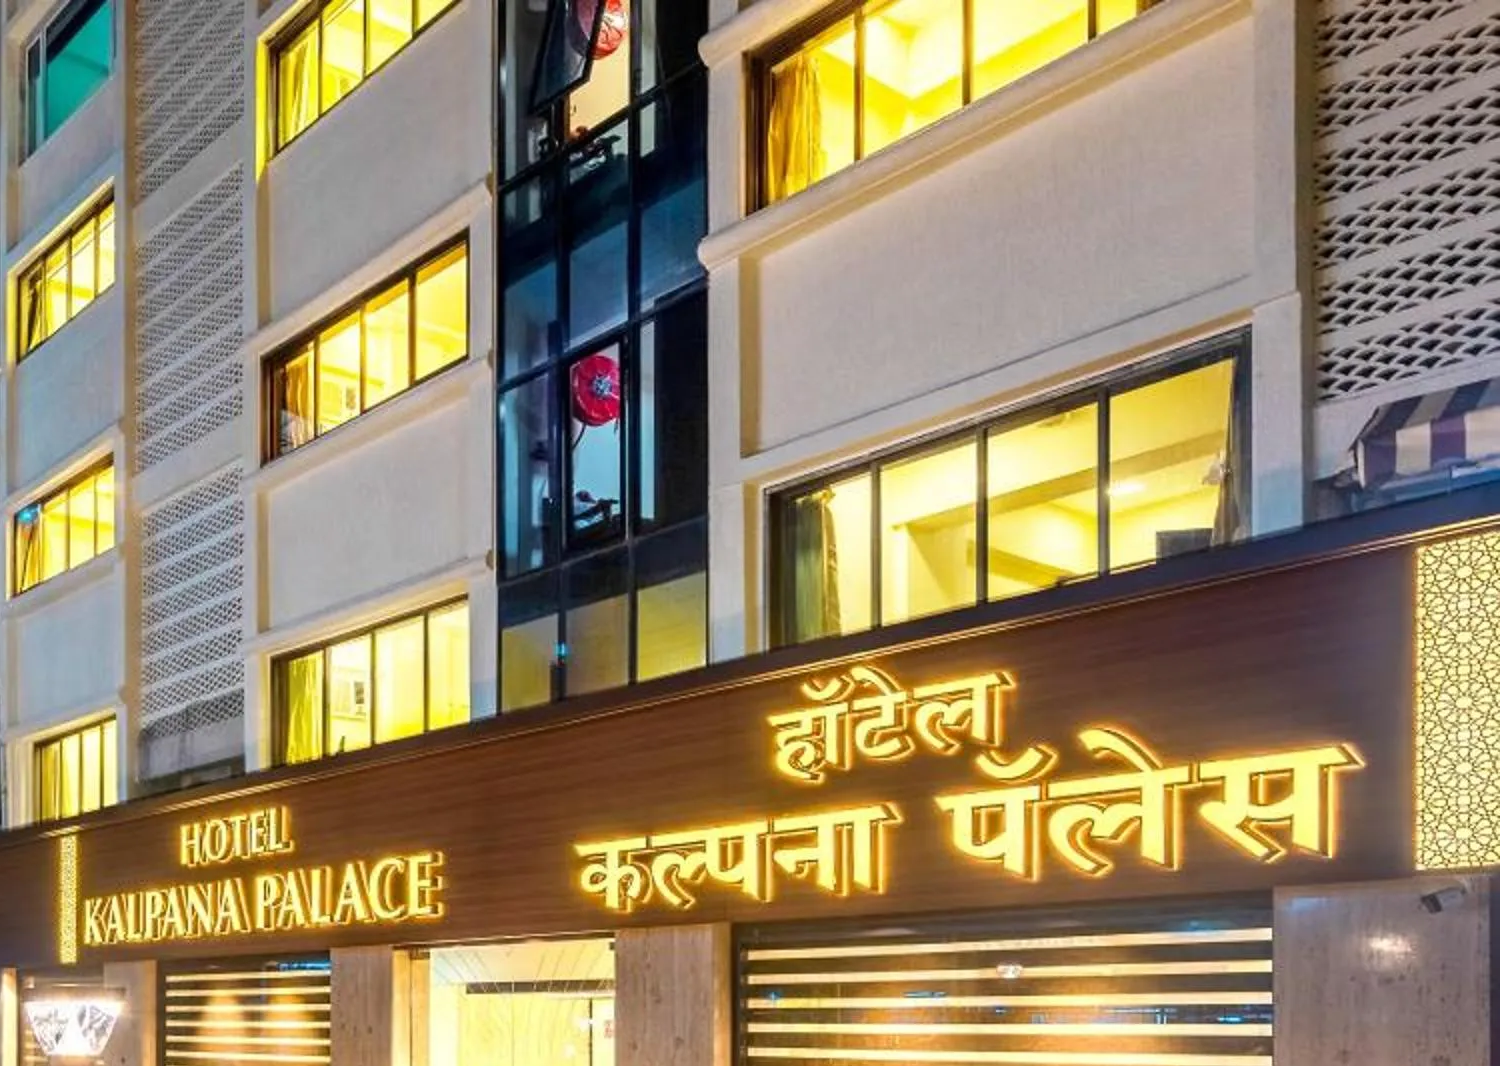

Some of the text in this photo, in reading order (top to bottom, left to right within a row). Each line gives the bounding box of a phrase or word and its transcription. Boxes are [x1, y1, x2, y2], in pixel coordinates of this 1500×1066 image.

[767, 666, 1014, 782] हॉटेल
[180, 807, 293, 867] HOTEL
[575, 728, 1365, 912] कल्पना पॅलेस
[84, 852, 444, 944] KALPANA PALACE
